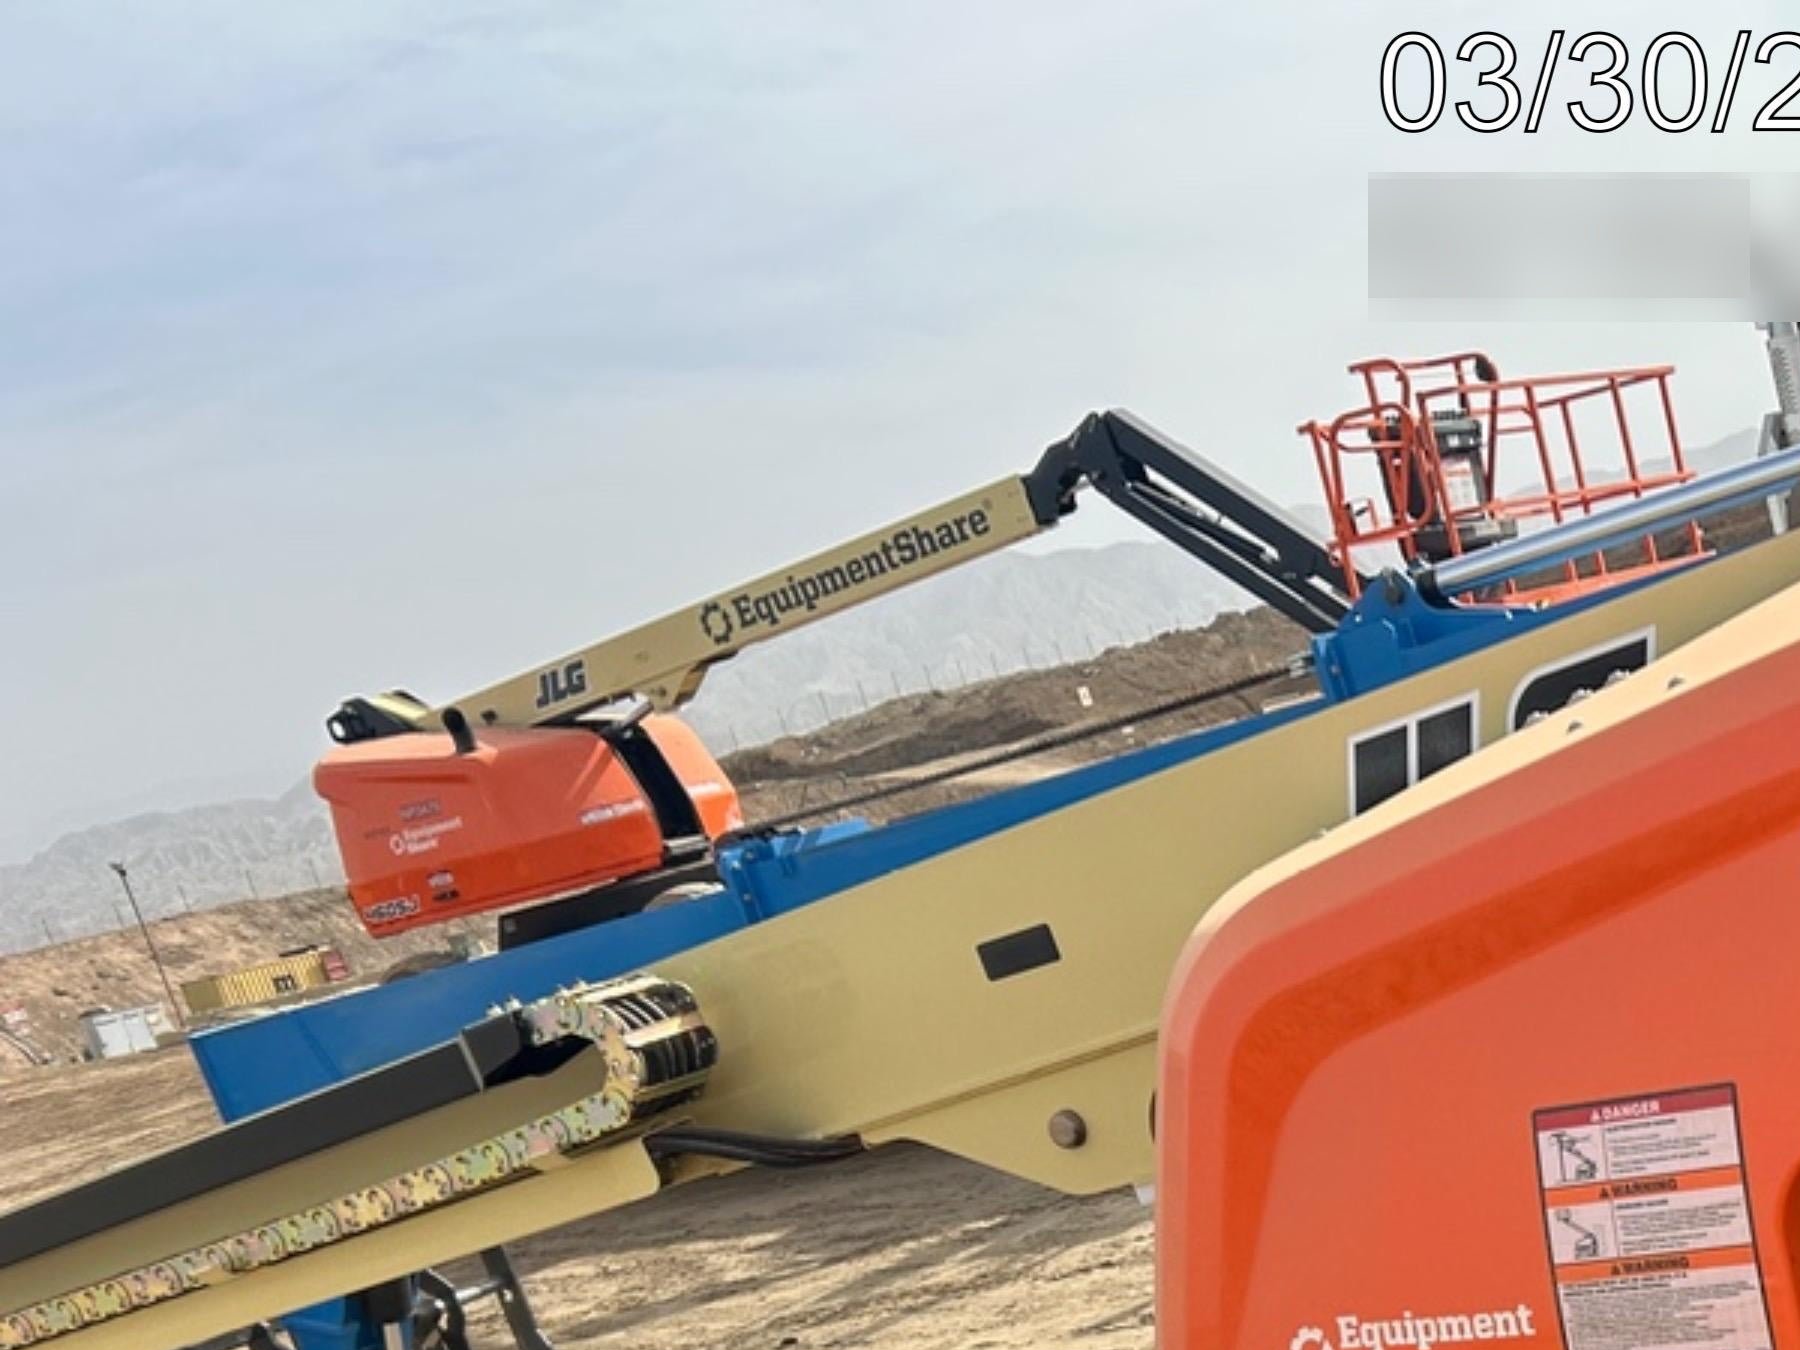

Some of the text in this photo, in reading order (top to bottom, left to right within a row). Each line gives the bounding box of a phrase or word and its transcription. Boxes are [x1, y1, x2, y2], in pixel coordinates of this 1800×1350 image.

[732, 507, 991, 627] EquipmentShare
[536, 660, 586, 708] JLG
[1601, 1100, 1661, 1121] DANGER
[1612, 1178, 1678, 1199] WARNING
[1621, 1256, 1690, 1275] WARNING
